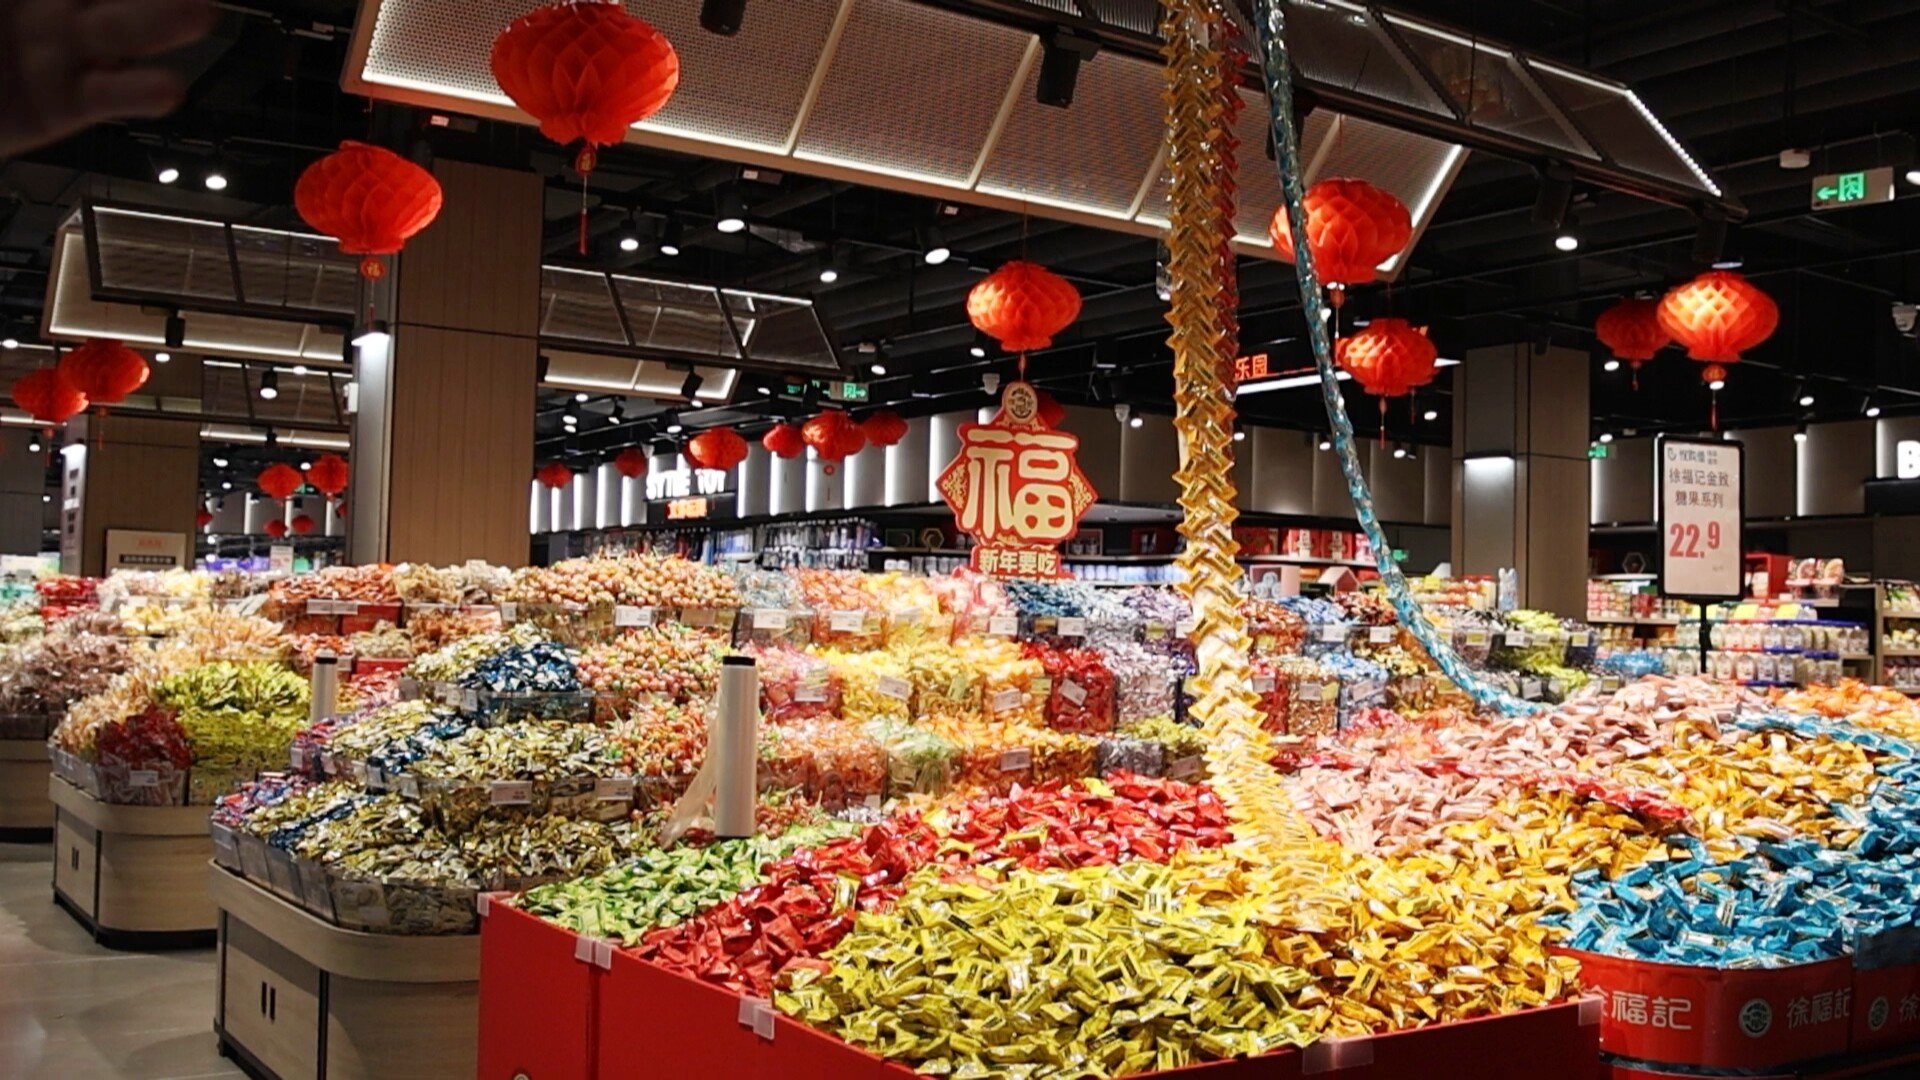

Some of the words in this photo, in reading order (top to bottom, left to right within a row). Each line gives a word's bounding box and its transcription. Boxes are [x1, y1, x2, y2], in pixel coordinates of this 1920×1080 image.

[1235, 354, 1268, 380] 乐园
[961, 429, 1077, 539] 福
[1675, 490, 1724, 508] 糖果系列
[1669, 521, 1720, 558] 22.9
[978, 548, 1057, 575] 新年要吃
